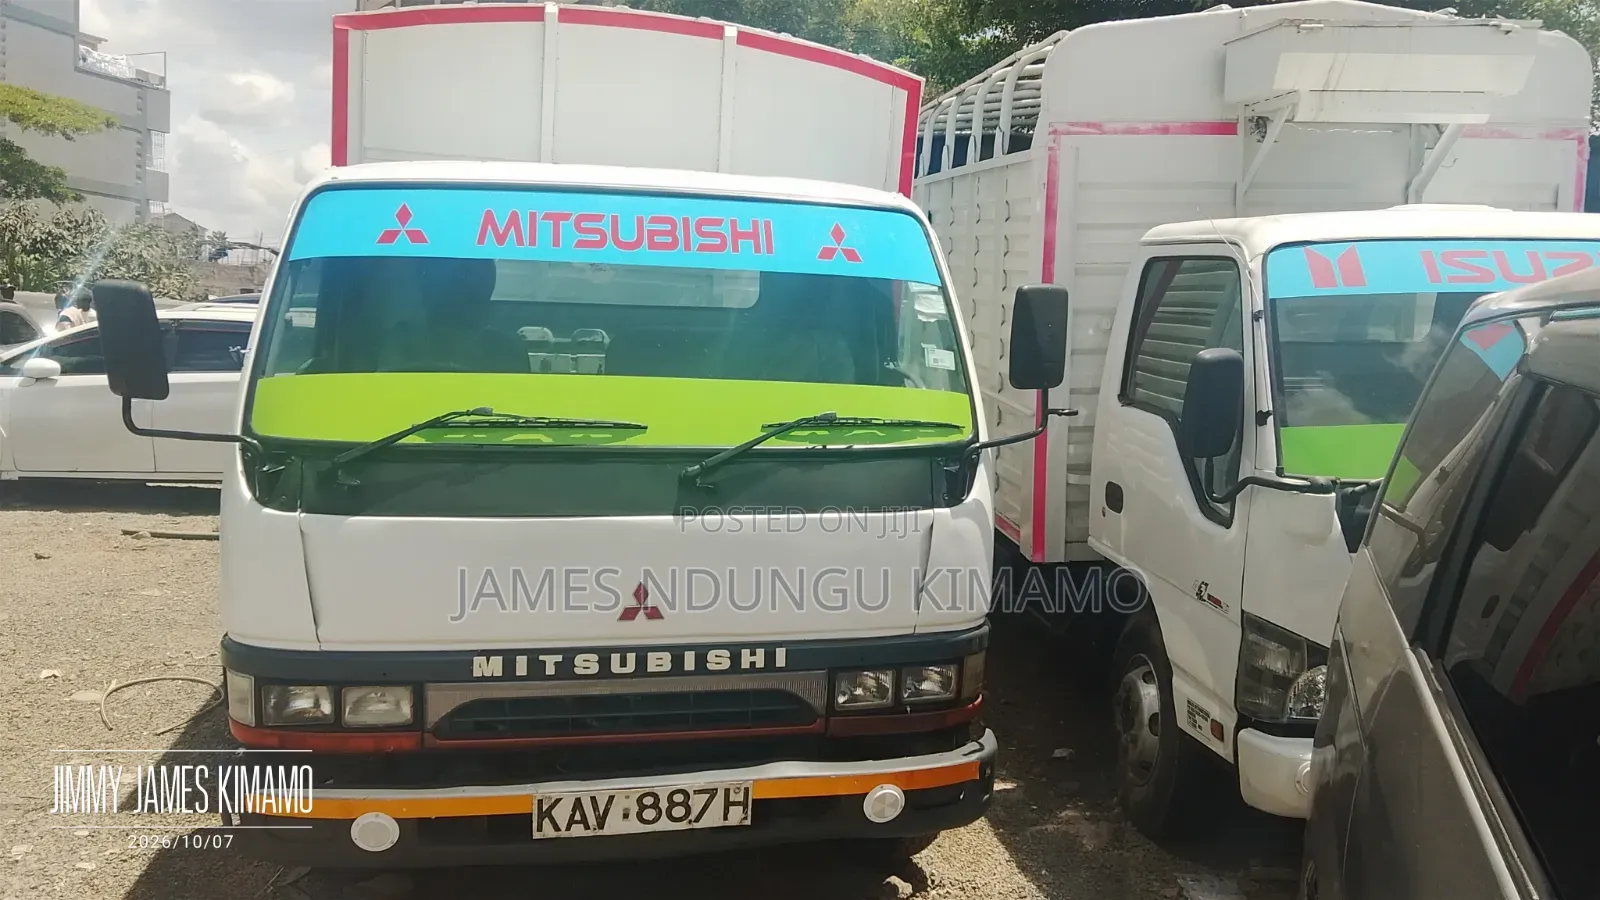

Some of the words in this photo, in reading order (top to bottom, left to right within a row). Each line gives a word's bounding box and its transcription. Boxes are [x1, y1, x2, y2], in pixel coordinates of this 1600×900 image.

[476, 208, 775, 255] MITSUBISHI
[1420, 250, 1600, 284] ISUZ
[472, 647, 786, 677] MITSUBISHI
[536, 795, 615, 833] KAV
[635, 786, 750, 826] 887H
